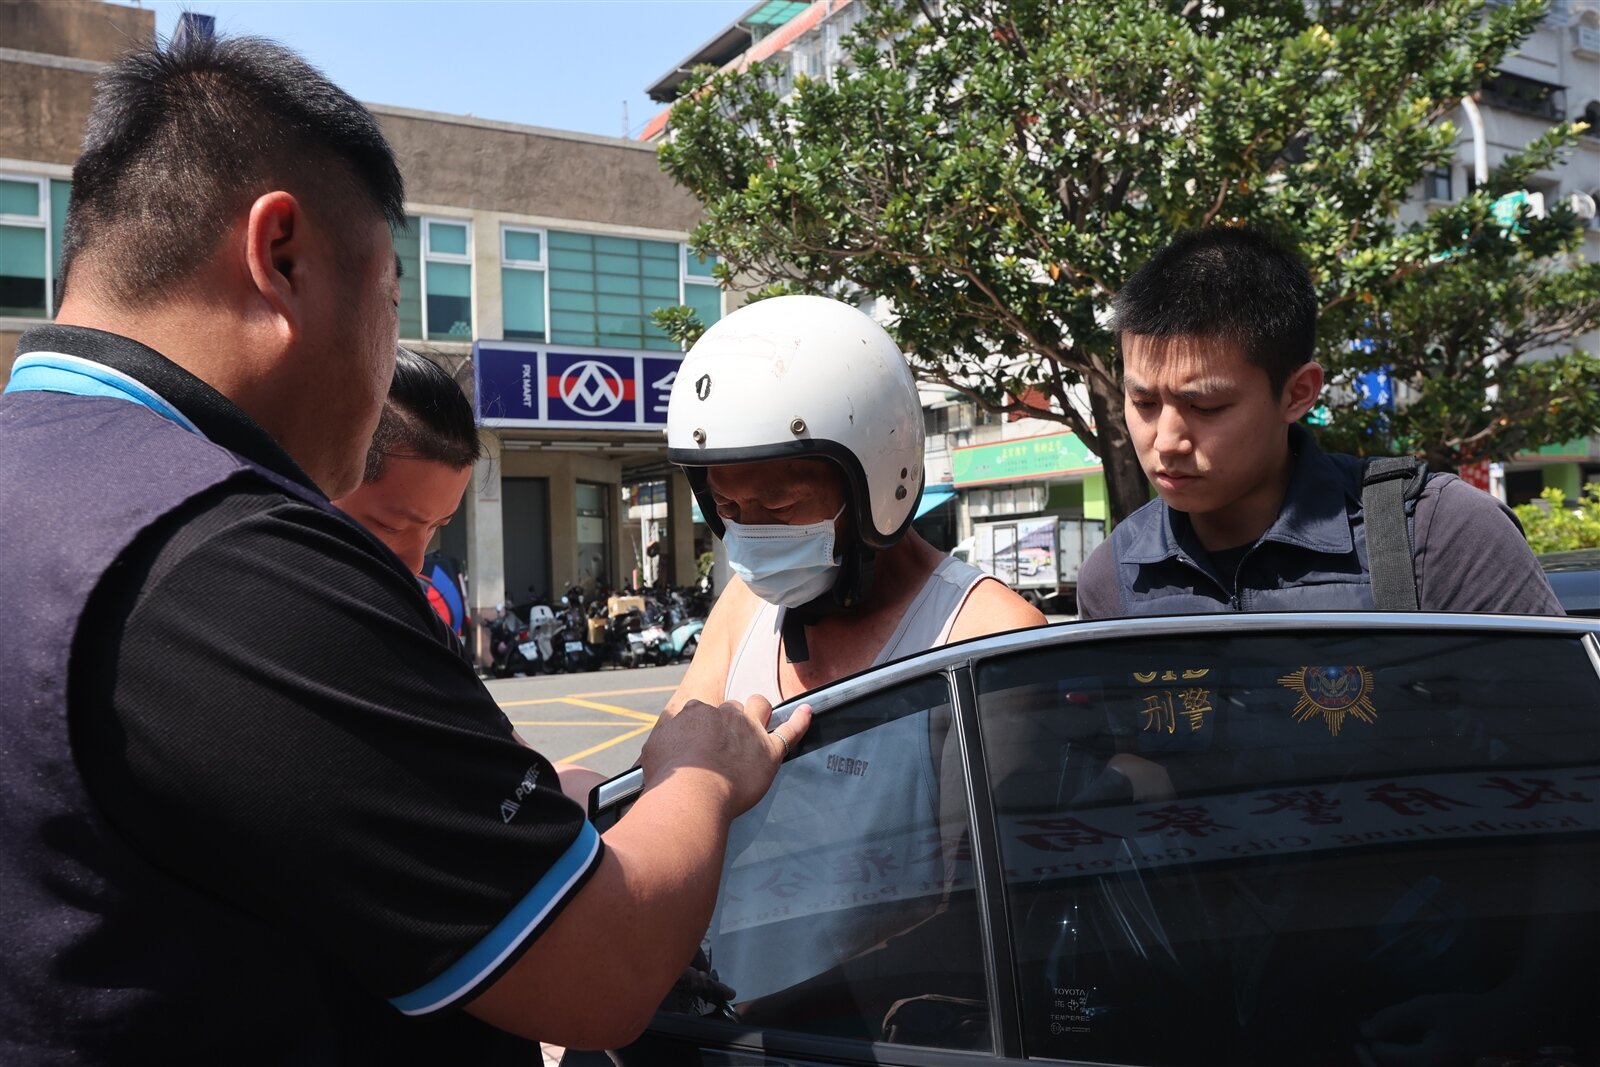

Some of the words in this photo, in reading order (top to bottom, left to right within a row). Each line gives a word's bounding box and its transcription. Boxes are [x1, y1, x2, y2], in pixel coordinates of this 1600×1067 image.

[522, 378, 532, 408] MART
[1139, 687, 1213, 734] 刑警
[826, 754, 869, 777] ENERGY
[1053, 987, 1086, 996] TOYOTA
